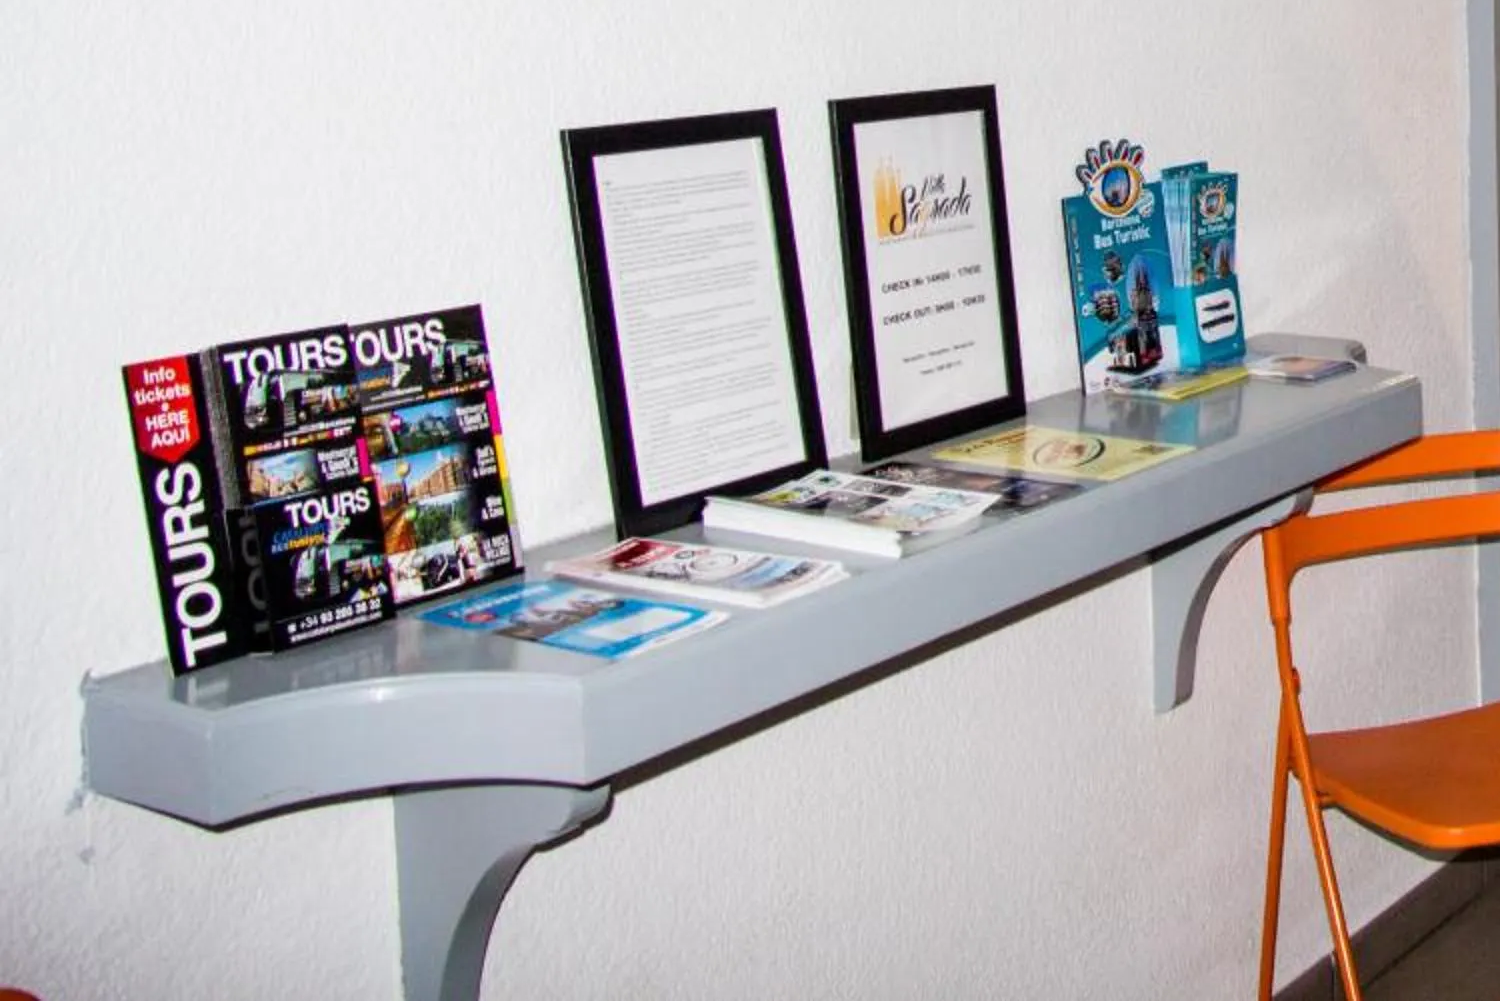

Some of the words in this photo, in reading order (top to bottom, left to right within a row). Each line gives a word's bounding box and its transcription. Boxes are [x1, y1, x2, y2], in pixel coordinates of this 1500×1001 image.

[883, 311, 912, 326] CHECK
[223, 336, 349, 385] TOURS
[350, 318, 447, 366] OURS
[143, 366, 176, 385] Info
[134, 383, 191, 406] tickets
[145, 408, 190, 432] HERE
[284, 487, 371, 528] TOURS
[155, 461, 228, 668] TOURS
